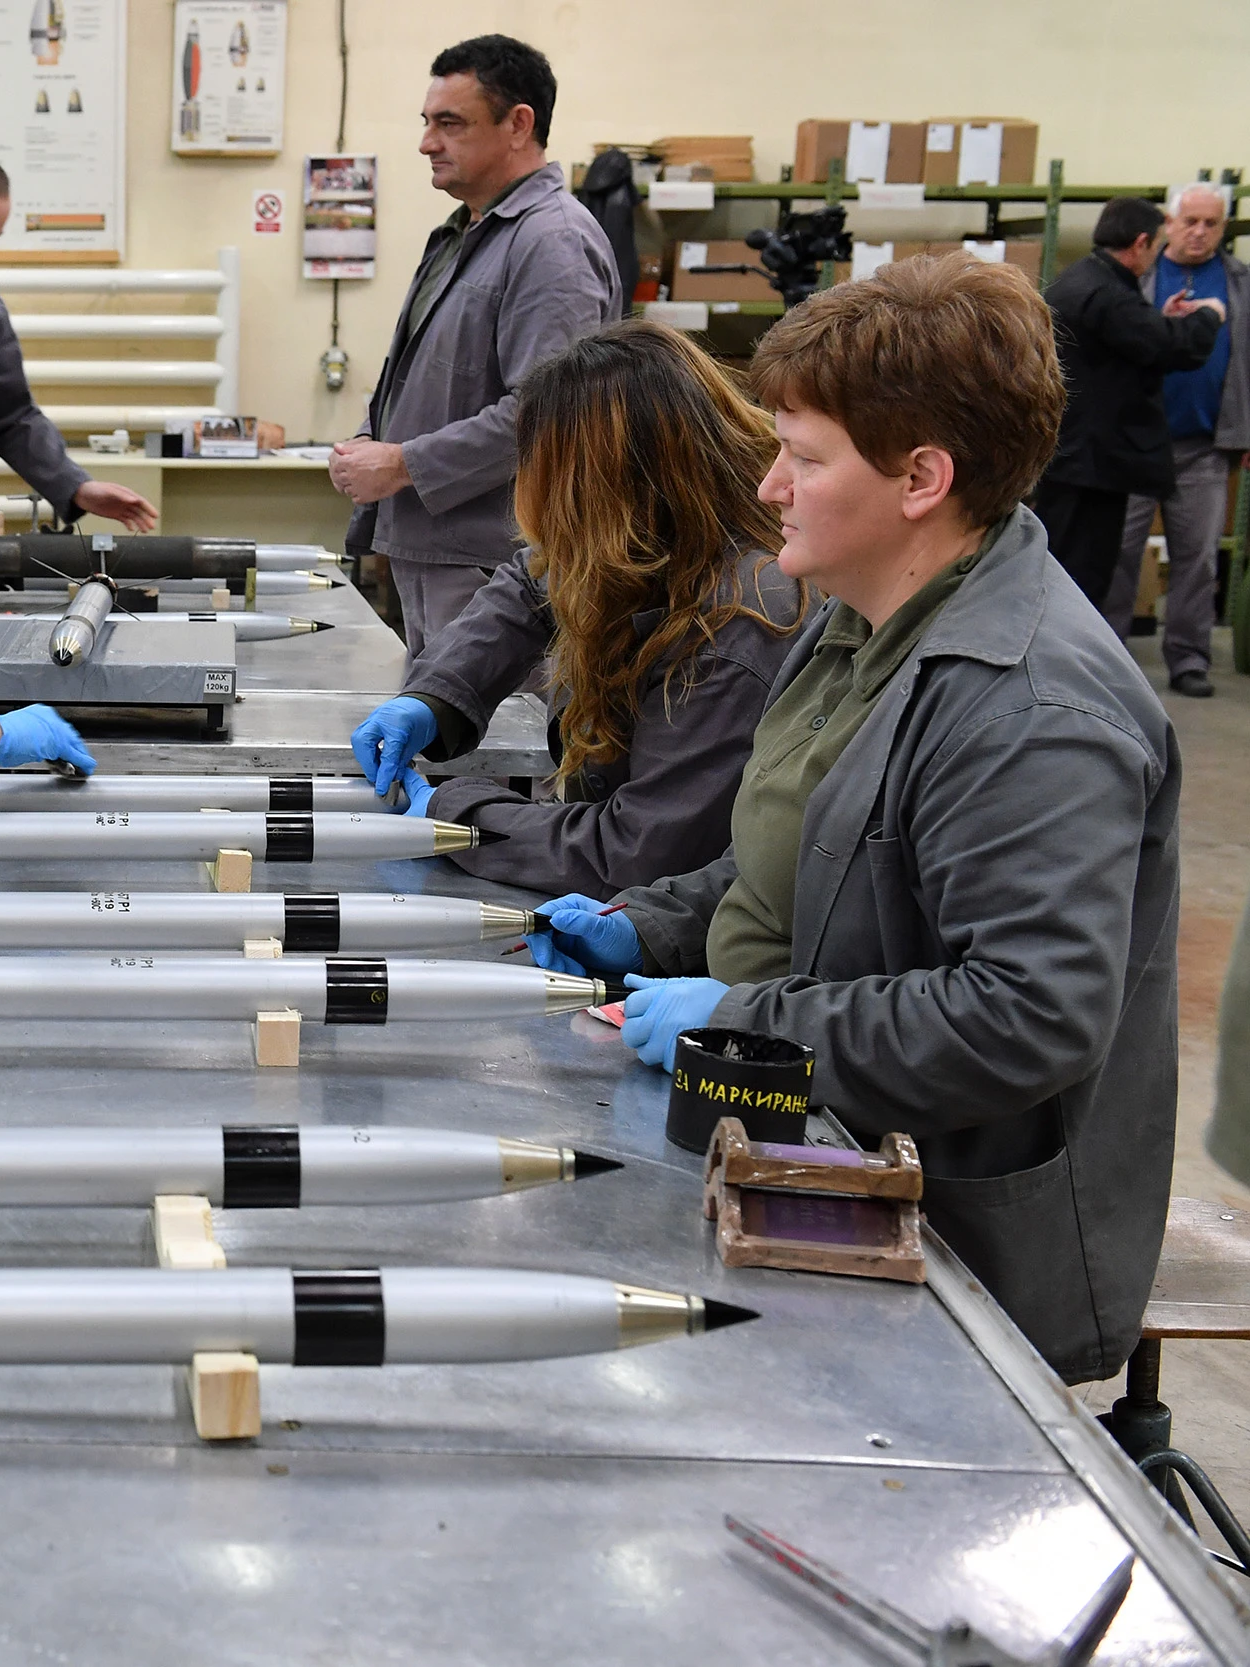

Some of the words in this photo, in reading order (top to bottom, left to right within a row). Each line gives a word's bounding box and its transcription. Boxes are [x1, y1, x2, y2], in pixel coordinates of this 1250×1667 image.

[207, 673, 227, 681] MAX
[206, 683, 229, 692] 120kg
[119, 818, 129, 827] P1
[117, 901, 130, 912] P1
